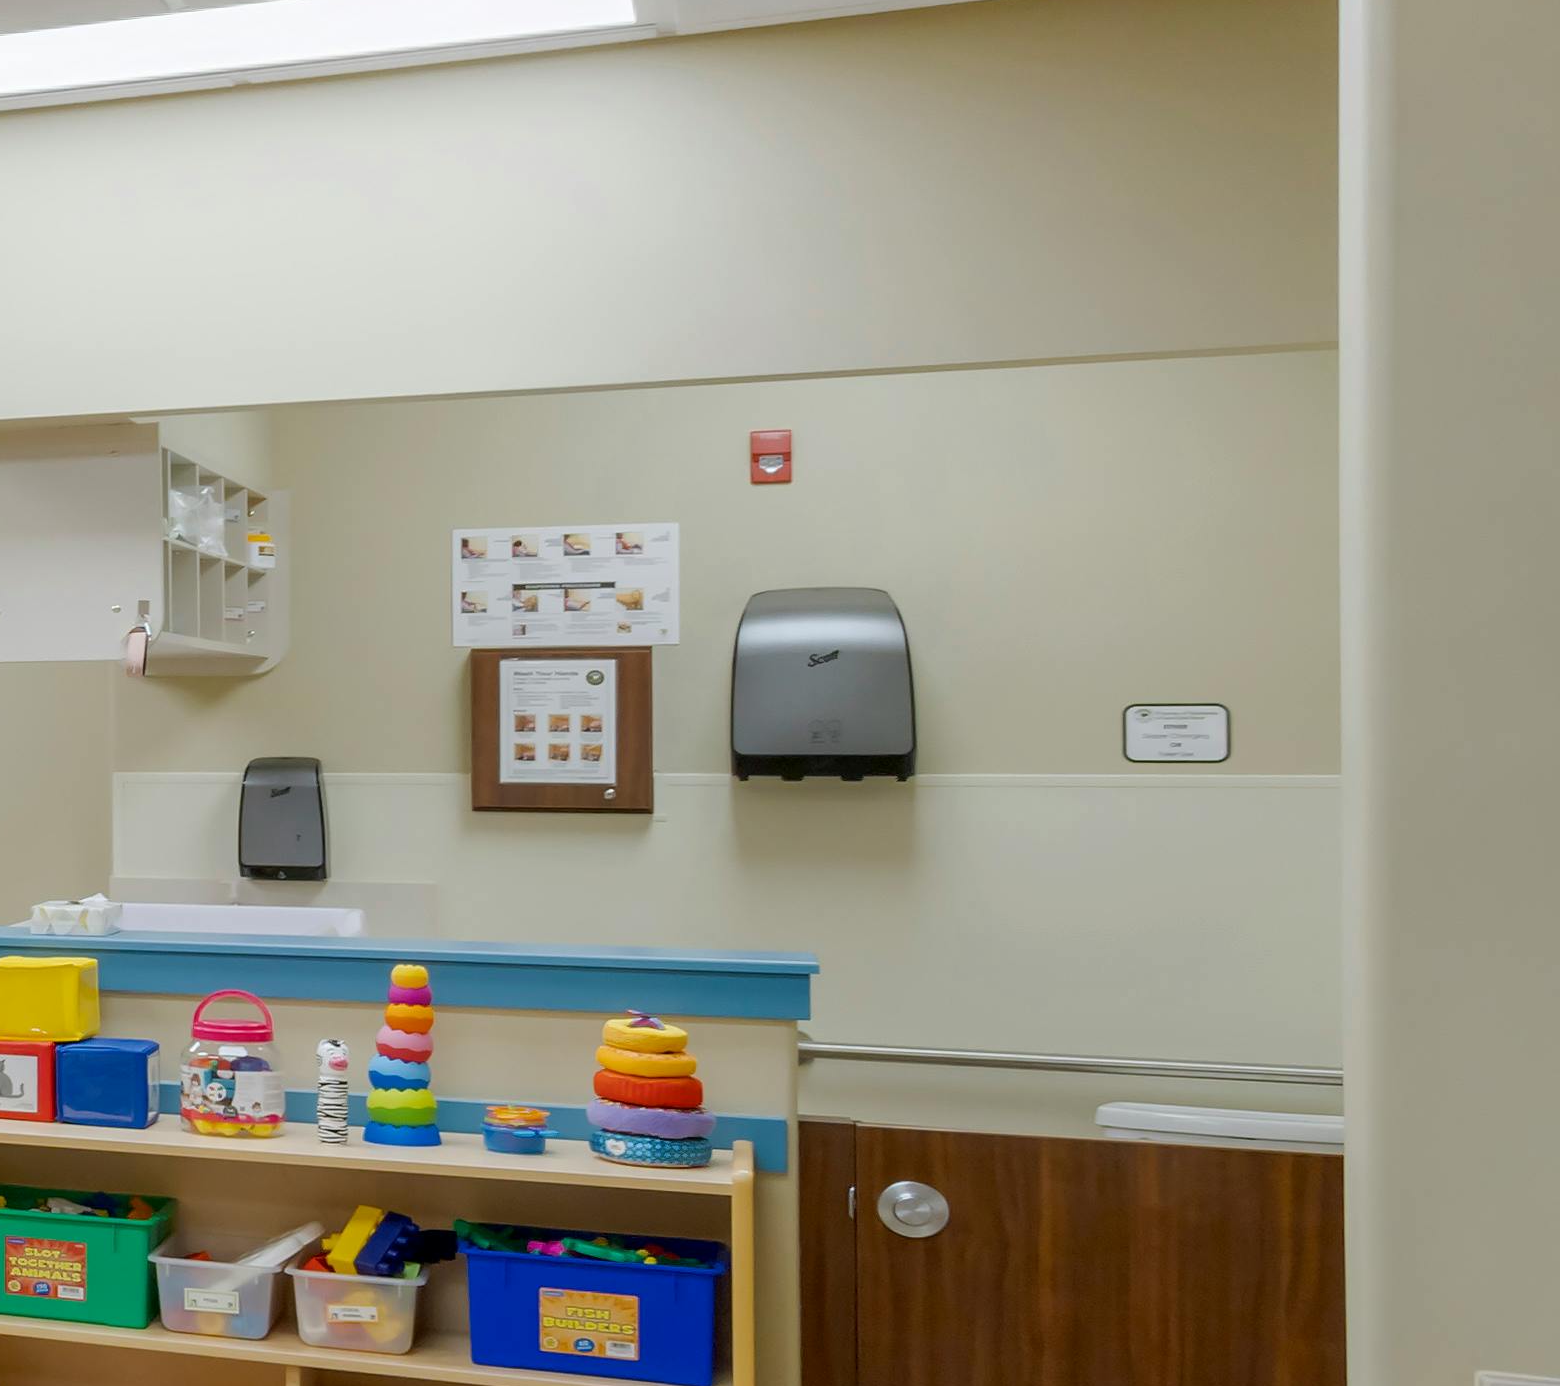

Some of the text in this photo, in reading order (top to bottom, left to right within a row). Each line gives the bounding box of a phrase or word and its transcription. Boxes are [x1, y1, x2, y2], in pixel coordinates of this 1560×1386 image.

[8, 1256, 83, 1272] TOGETHER
[10, 1266, 82, 1283] ANIMALS
[566, 1305, 611, 1320] FISH
[542, 1316, 636, 1336] BUILDERS
